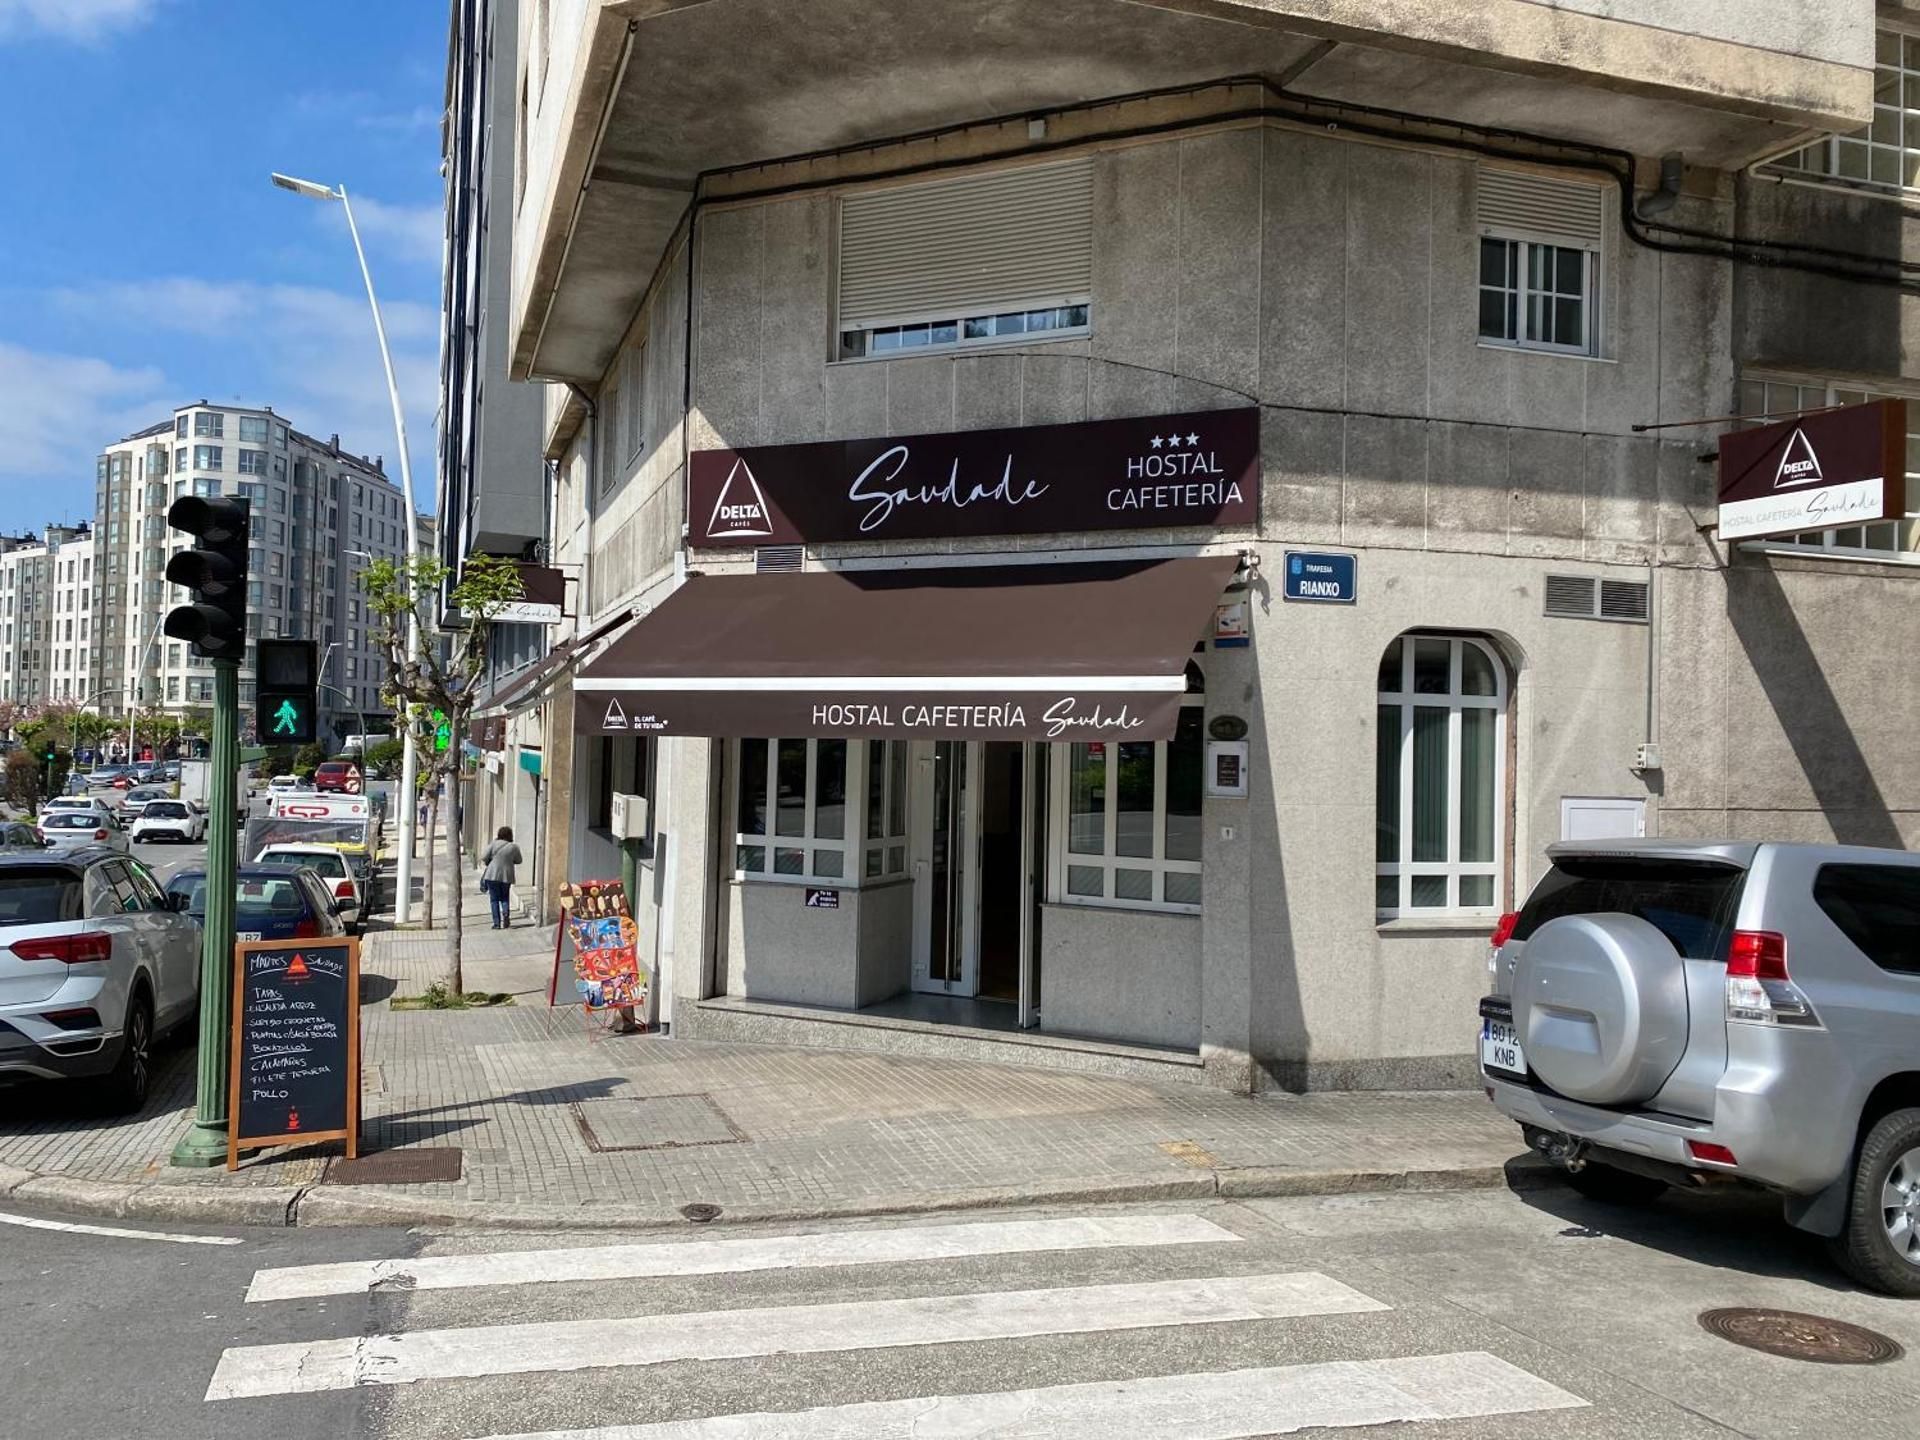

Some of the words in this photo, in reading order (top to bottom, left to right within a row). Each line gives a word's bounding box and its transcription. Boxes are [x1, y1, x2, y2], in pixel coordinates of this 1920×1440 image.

[1128, 451, 1224, 478] HOSTAL
[1783, 460, 1814, 474] DELTA
[848, 445, 1050, 531] Saudade
[1107, 478, 1244, 510] CAFETERÍA
[720, 503, 761, 519] DELTA
[1806, 491, 1879, 525] Saudade
[1300, 580, 1340, 597] RIANXO
[811, 704, 895, 727] HOSTAL
[901, 702, 1027, 728] CAFETERÍA
[1042, 697, 1145, 737] Saudade
[1494, 1046, 1516, 1067] KNB
[252, 1089, 289, 1102] POLLO
